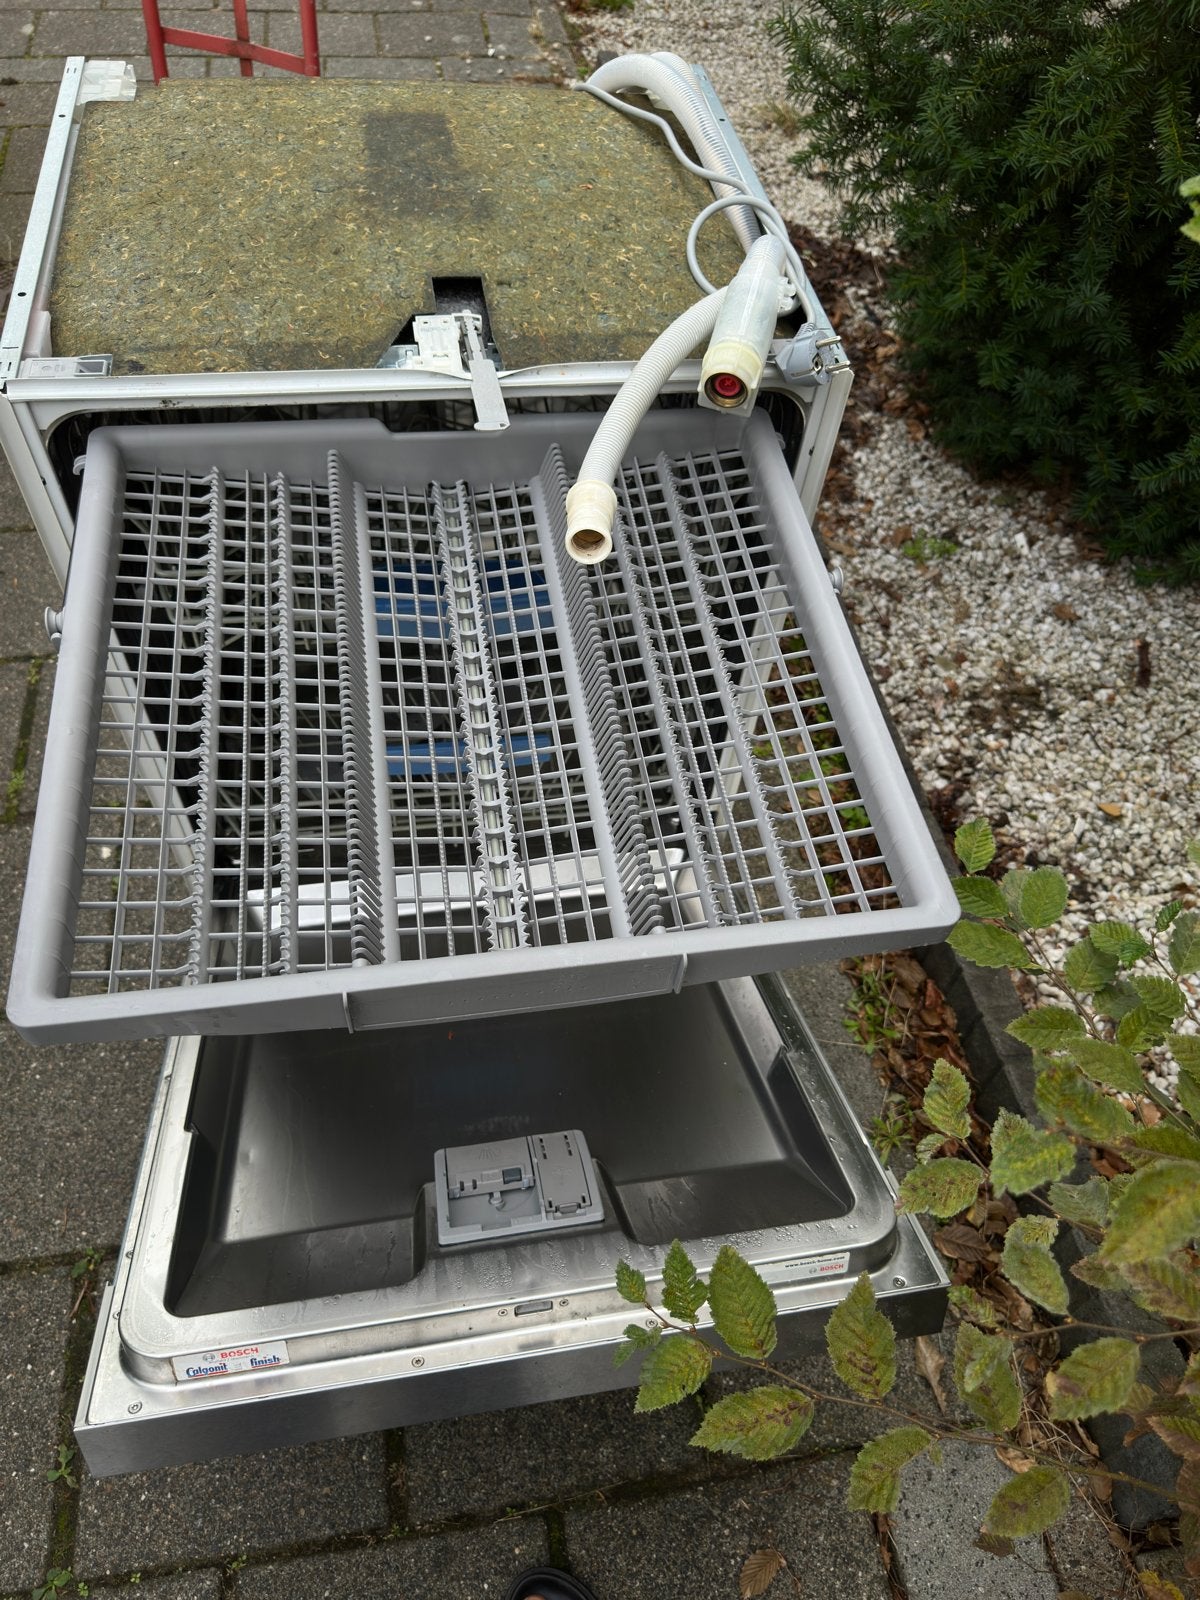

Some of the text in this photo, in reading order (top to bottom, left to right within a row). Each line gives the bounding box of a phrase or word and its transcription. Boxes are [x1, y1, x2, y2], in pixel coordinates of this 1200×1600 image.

[820, 1264, 844, 1272] BOSCH
[220, 1347, 260, 1359] BOSCH
[250, 1355, 281, 1367] finish
[186, 1362, 228, 1377] Calgonit
